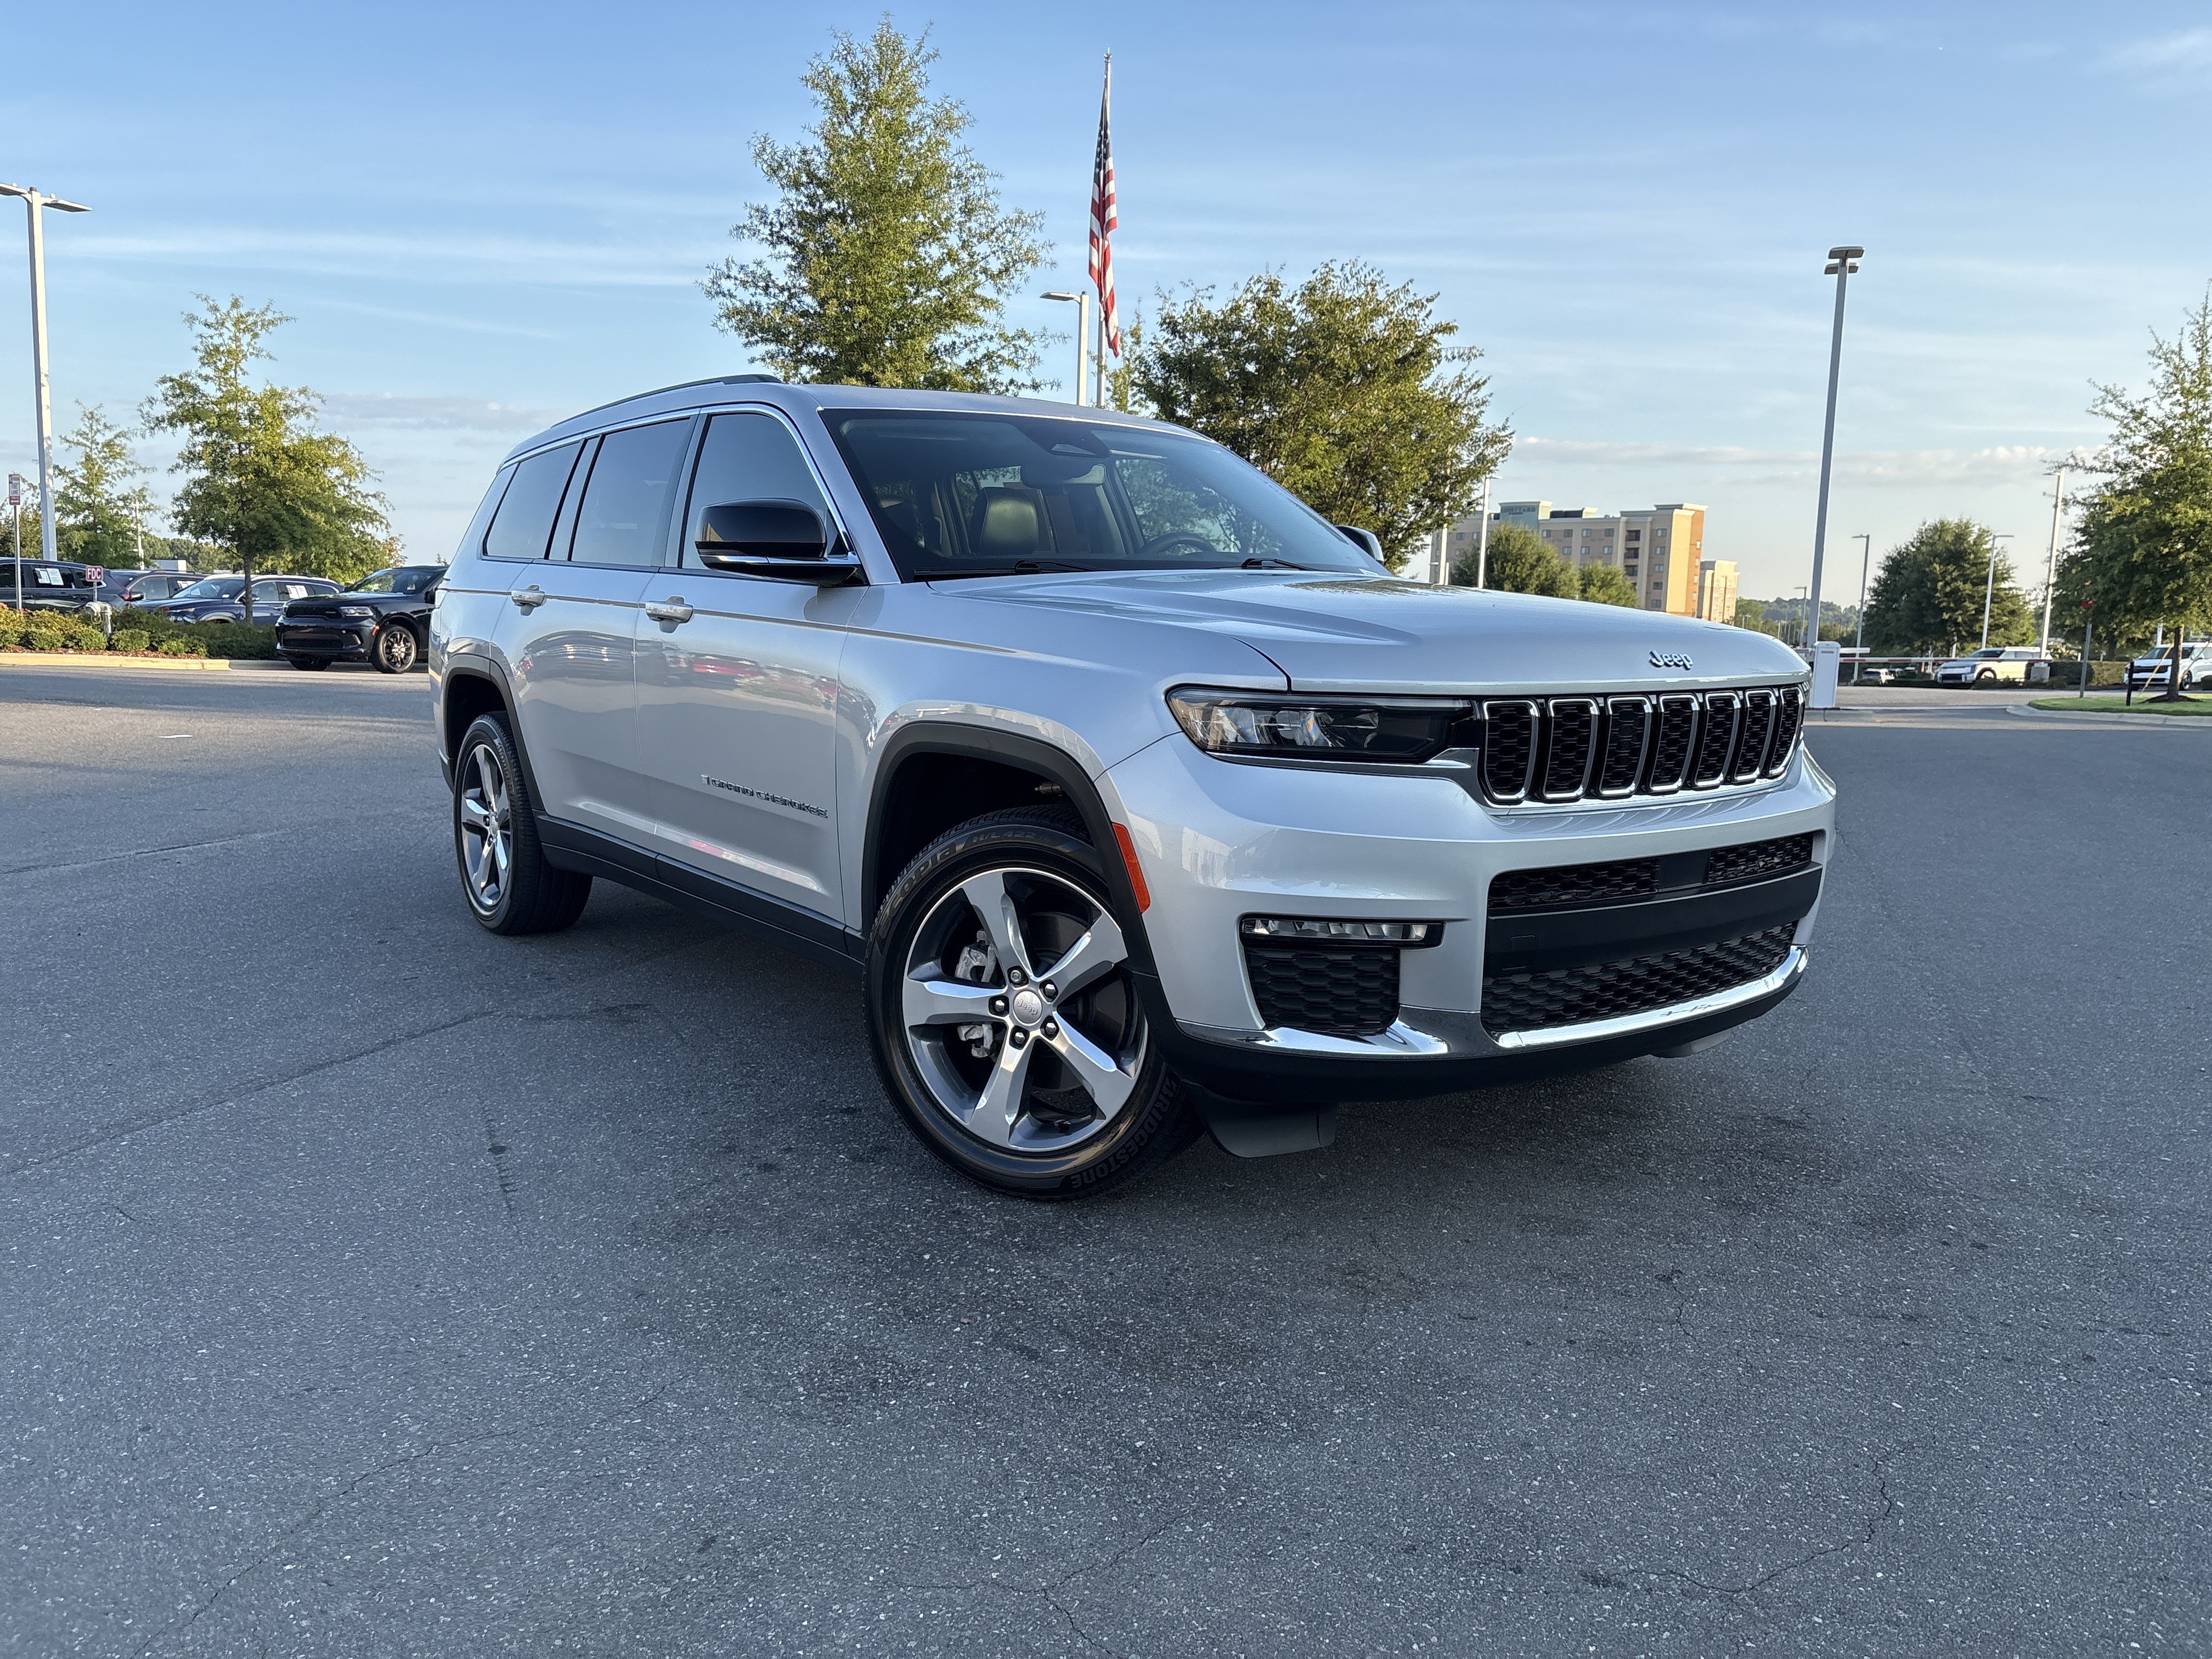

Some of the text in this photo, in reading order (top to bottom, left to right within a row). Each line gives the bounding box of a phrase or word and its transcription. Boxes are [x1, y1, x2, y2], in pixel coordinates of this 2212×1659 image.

[87, 568, 101, 579] FDC
[1649, 650, 1694, 670] Jeep
[711, 777, 828, 819] GRAND CHEROKEE
[1003, 830, 1036, 839] 422
[1016, 998, 1038, 1015] Jeep
[1070, 1076, 1177, 1189] BRIDGESTONE
